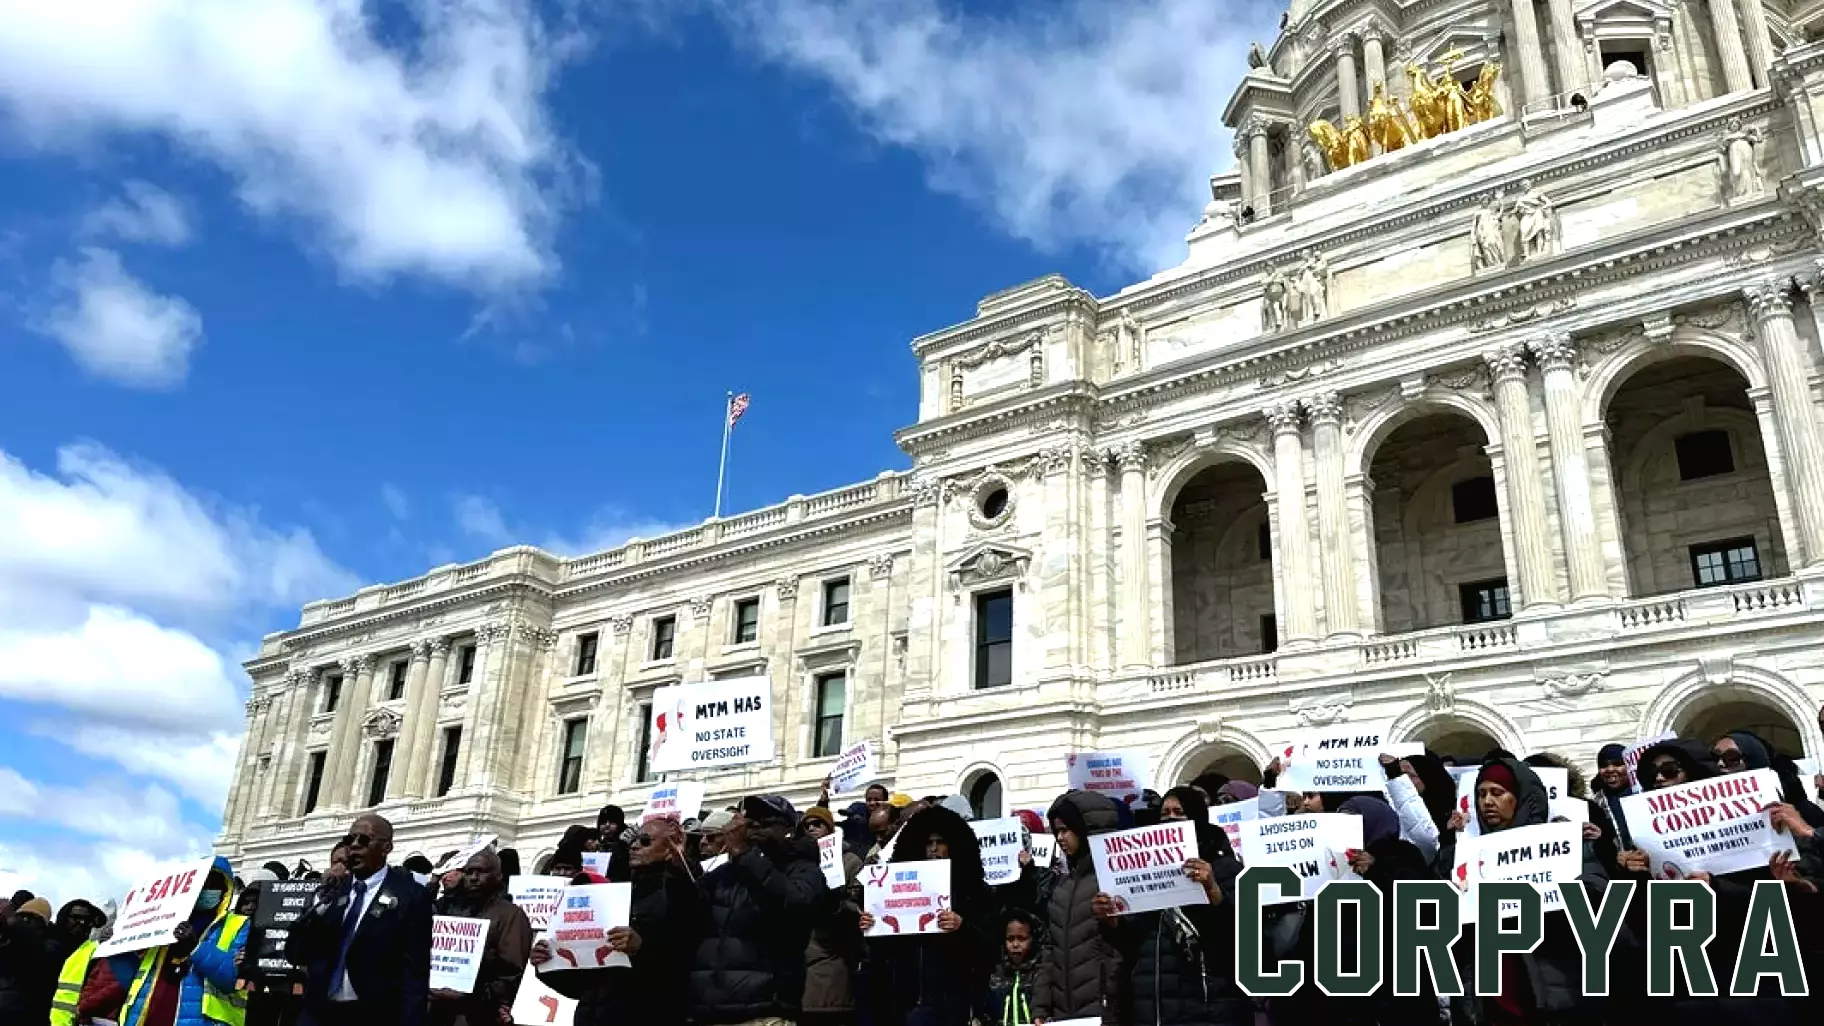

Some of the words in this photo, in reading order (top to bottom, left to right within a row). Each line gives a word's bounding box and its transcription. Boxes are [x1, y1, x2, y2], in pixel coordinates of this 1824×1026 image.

[695, 700, 729, 720] MTM
[734, 695, 762, 714] HAS
[695, 730, 711, 743] NO
[713, 726, 747, 741] STATE
[1318, 737, 1349, 750] MTM
[1354, 735, 1379, 747] HAS
[691, 744, 751, 763] OVERSIGHT
[1316, 758, 1331, 769] NO
[1332, 757, 1363, 769] STATE
[1312, 774, 1368, 787] OVERSIGHT
[1646, 776, 1760, 814] MISSOURI
[1652, 794, 1763, 835] COMPANY
[1259, 819, 1317, 836] OVERSIGHT
[1663, 833, 1700, 850] CAUSING
[1701, 831, 1717, 841] MN
[1718, 819, 1766, 838] SUFFERING
[999, 831, 1018, 847] HAS
[1103, 826, 1185, 856] MISSOURI
[1266, 839, 1297, 855] STATE
[1299, 837, 1314, 849] NO
[1108, 844, 1187, 874] COMPANY
[1497, 846, 1533, 867] MTM
[1539, 840, 1571, 858] HAS
[1683, 846, 1706, 859] WITH
[1292, 860, 1321, 878] MT
[144, 868, 198, 903] SAVE
[432, 936, 479, 954] OMPANY
